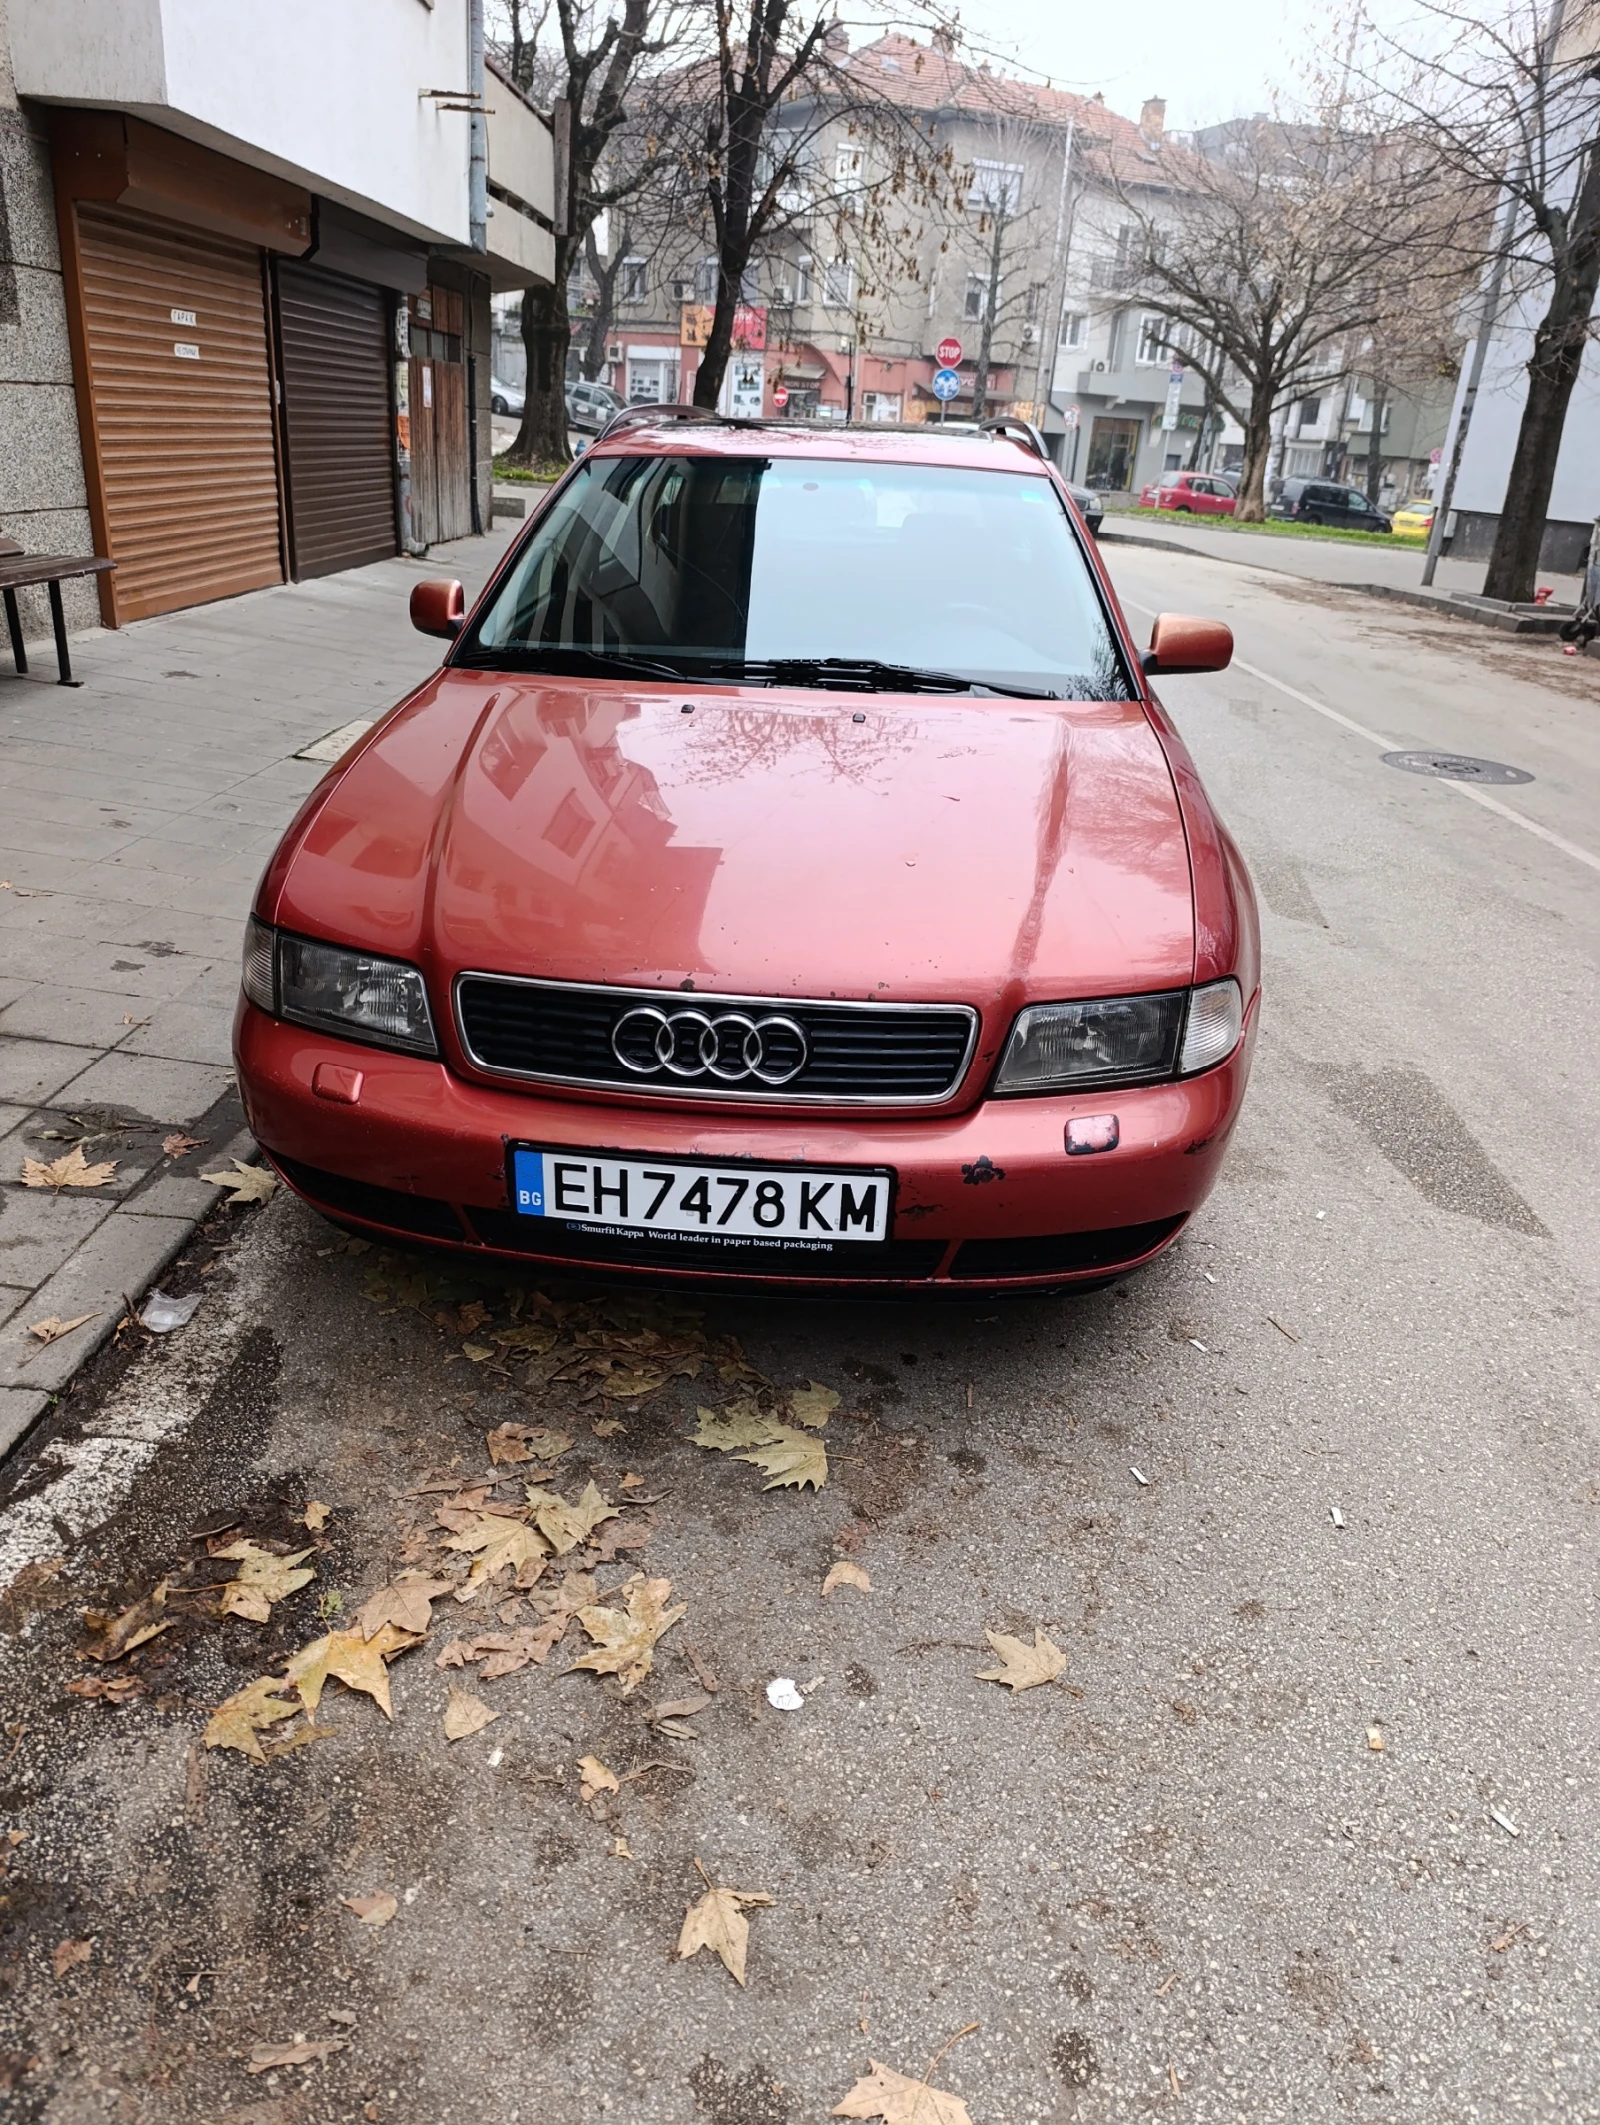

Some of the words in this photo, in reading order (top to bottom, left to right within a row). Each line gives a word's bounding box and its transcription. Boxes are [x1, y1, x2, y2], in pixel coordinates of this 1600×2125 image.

[938, 345, 961, 359] STOP
[519, 1190, 542, 1206] BG
[581, 1223, 615, 1235] Smurfit
[616, 1227, 644, 1239] Kappa
[648, 1230, 677, 1241] World
[680, 1233, 709, 1243] leader
[711, 1235, 721, 1244] in
[723, 1238, 751, 1247] paper
[753, 1238, 781, 1247] based
[783, 1240, 833, 1251] packaging
